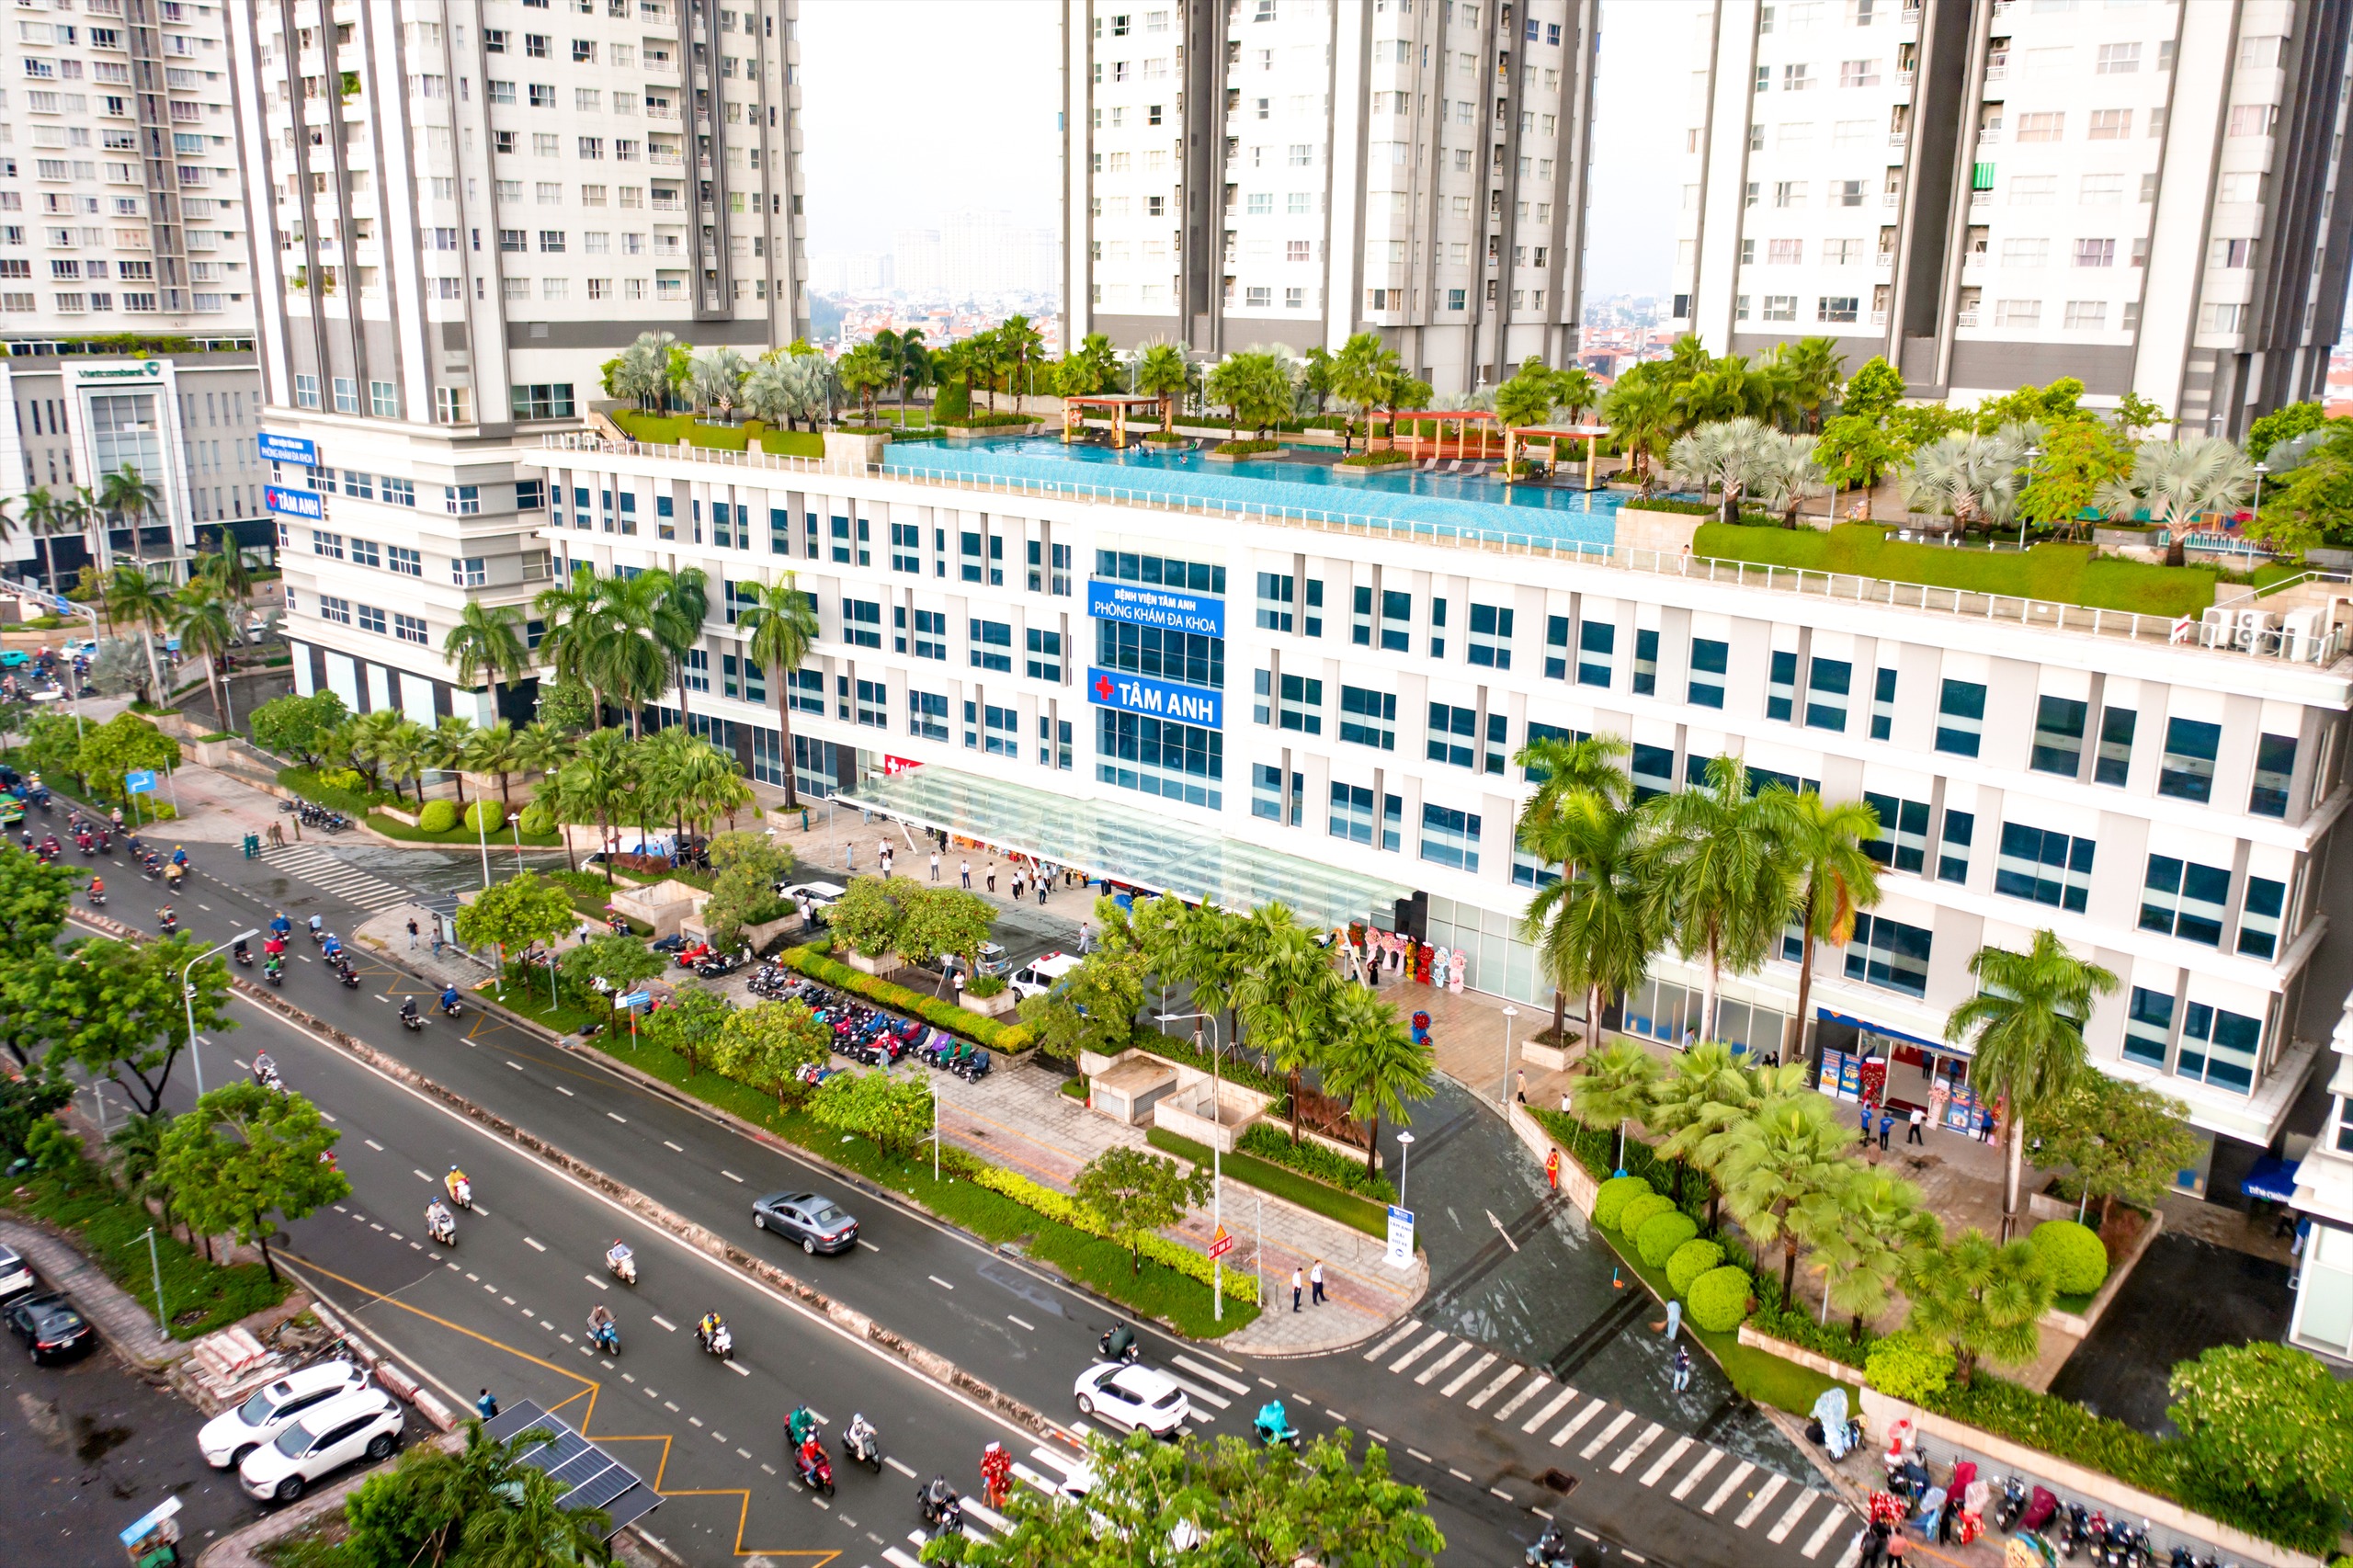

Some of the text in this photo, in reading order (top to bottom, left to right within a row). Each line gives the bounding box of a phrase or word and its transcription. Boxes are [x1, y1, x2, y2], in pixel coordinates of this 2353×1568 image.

[277, 491, 319, 516] TÂM ANH
[1114, 589, 1196, 611] BỆNH VIỆN TÂM ANH
[1095, 601, 1216, 633] PHÒNG KHÁM ĐA KHOA
[1119, 682, 1213, 722] TÂM ANH
[1845, 1069, 1859, 1079] VIP
